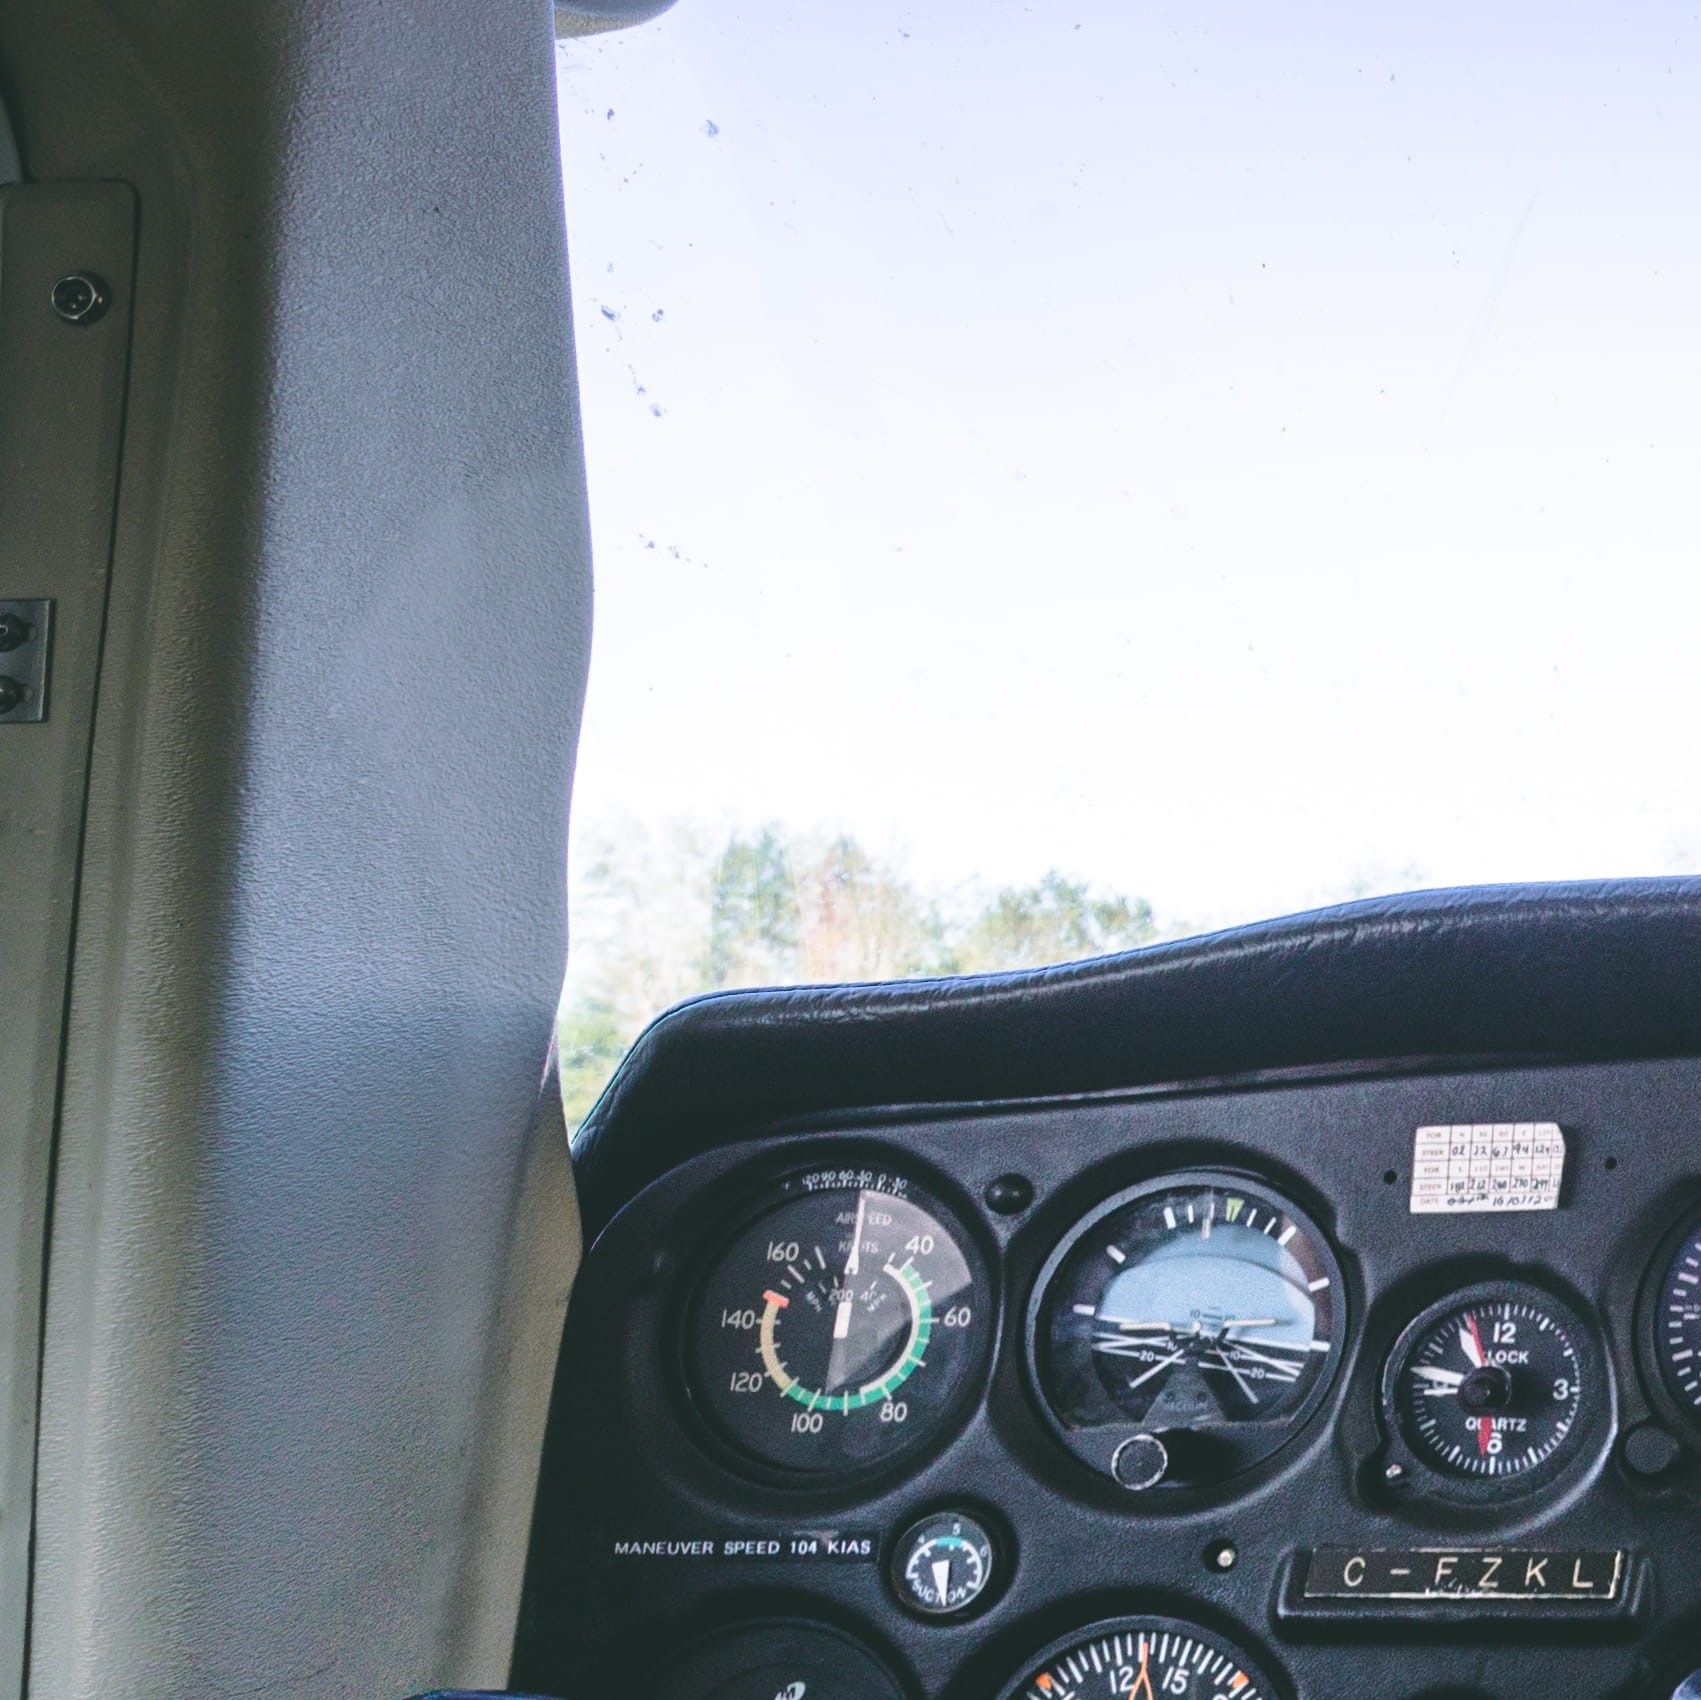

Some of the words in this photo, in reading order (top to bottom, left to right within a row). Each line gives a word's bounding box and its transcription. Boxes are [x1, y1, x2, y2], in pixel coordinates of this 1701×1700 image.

[767, 1241, 800, 1261] 160
[905, 1235, 935, 1255] 40
[721, 1309, 755, 1329] 140
[943, 1307, 972, 1327] 60
[1493, 1323, 1516, 1343] 12
[1139, 1351, 1155, 1362] 20
[1483, 1351, 1529, 1365] LOCK
[730, 1372, 762, 1392] 120
[1250, 1368, 1265, 1379] 20
[1553, 1379, 1570, 1401] 3
[880, 1403, 908, 1422] 80
[791, 1413, 823, 1433] 100
[614, 1541, 714, 1556] MANEUVER
[724, 1541, 780, 1555] SPEED
[789, 1541, 817, 1555] 104
[828, 1540, 871, 1555] KIAS
[1110, 1667, 1135, 1694] 12
[1163, 1667, 1189, 1695] 15
